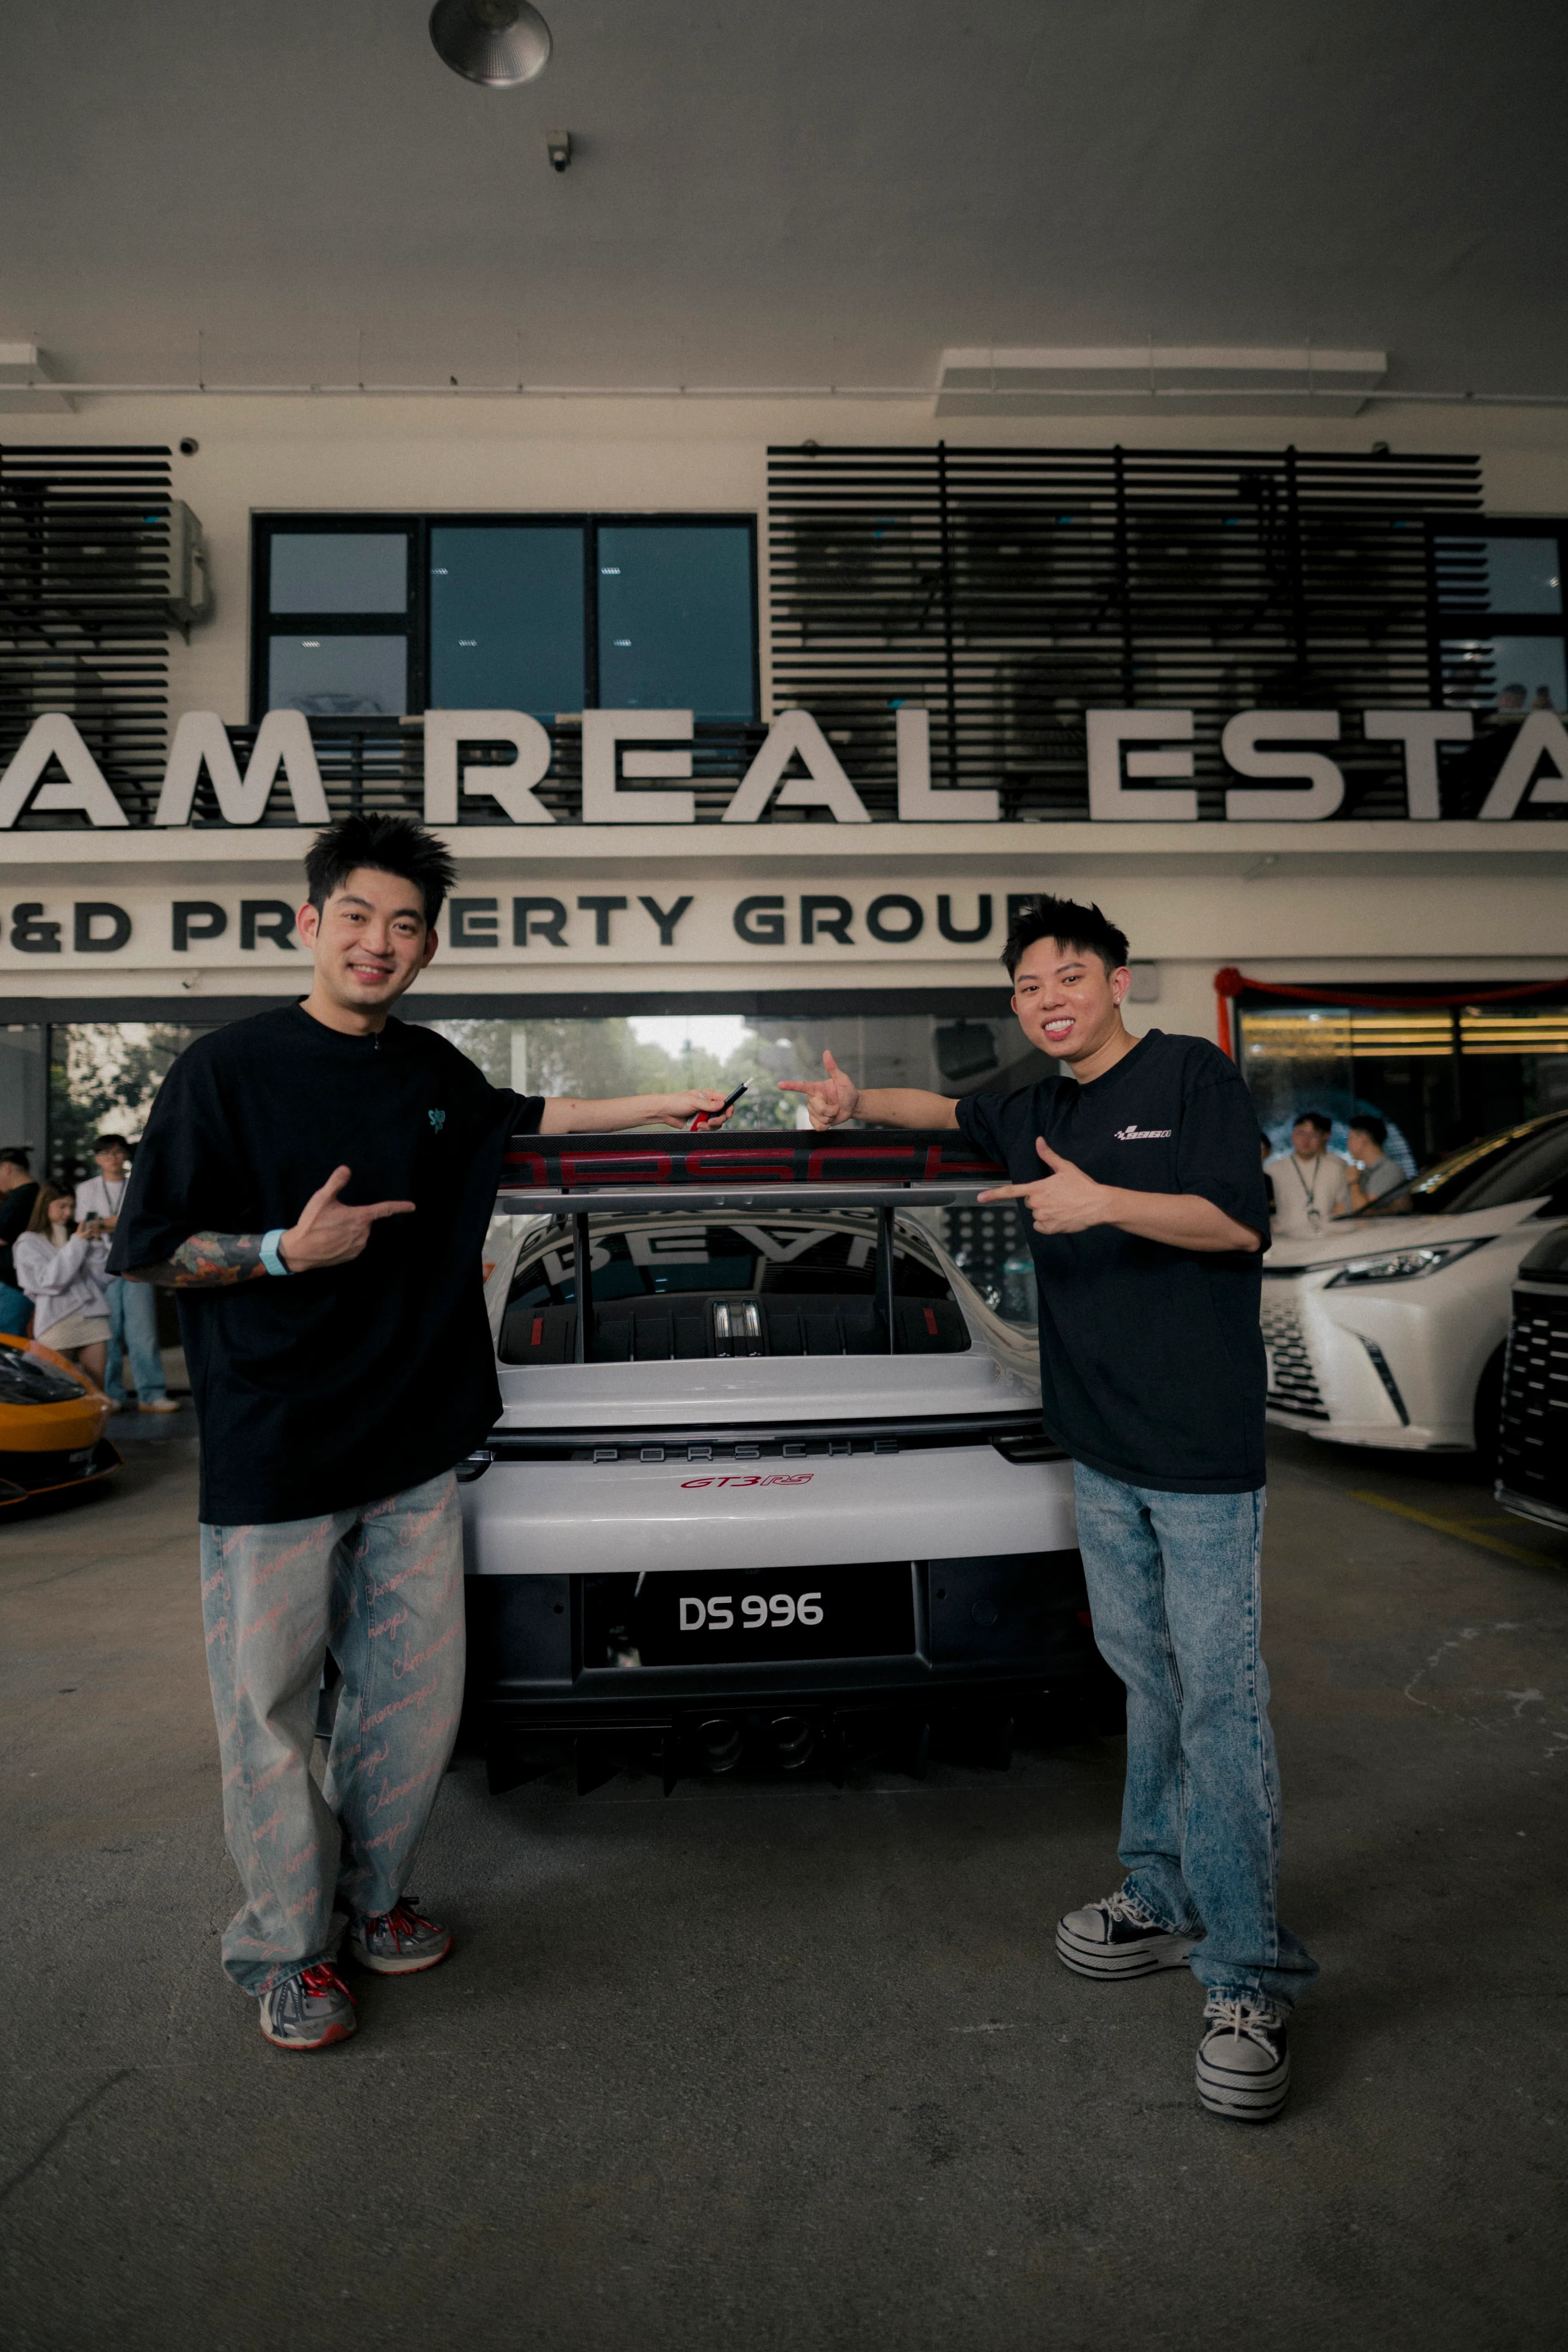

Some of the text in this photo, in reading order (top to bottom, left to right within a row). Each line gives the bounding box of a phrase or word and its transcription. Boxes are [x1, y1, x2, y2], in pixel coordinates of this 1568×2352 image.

[0, 709, 332, 828] AM
[424, 708, 1000, 824] REAL
[0, 902, 132, 953] &D
[172, 895, 694, 952] PRERTY
[592, 1439, 900, 1464] PORSCHE
[679, 1592, 824, 1630] DS 996
